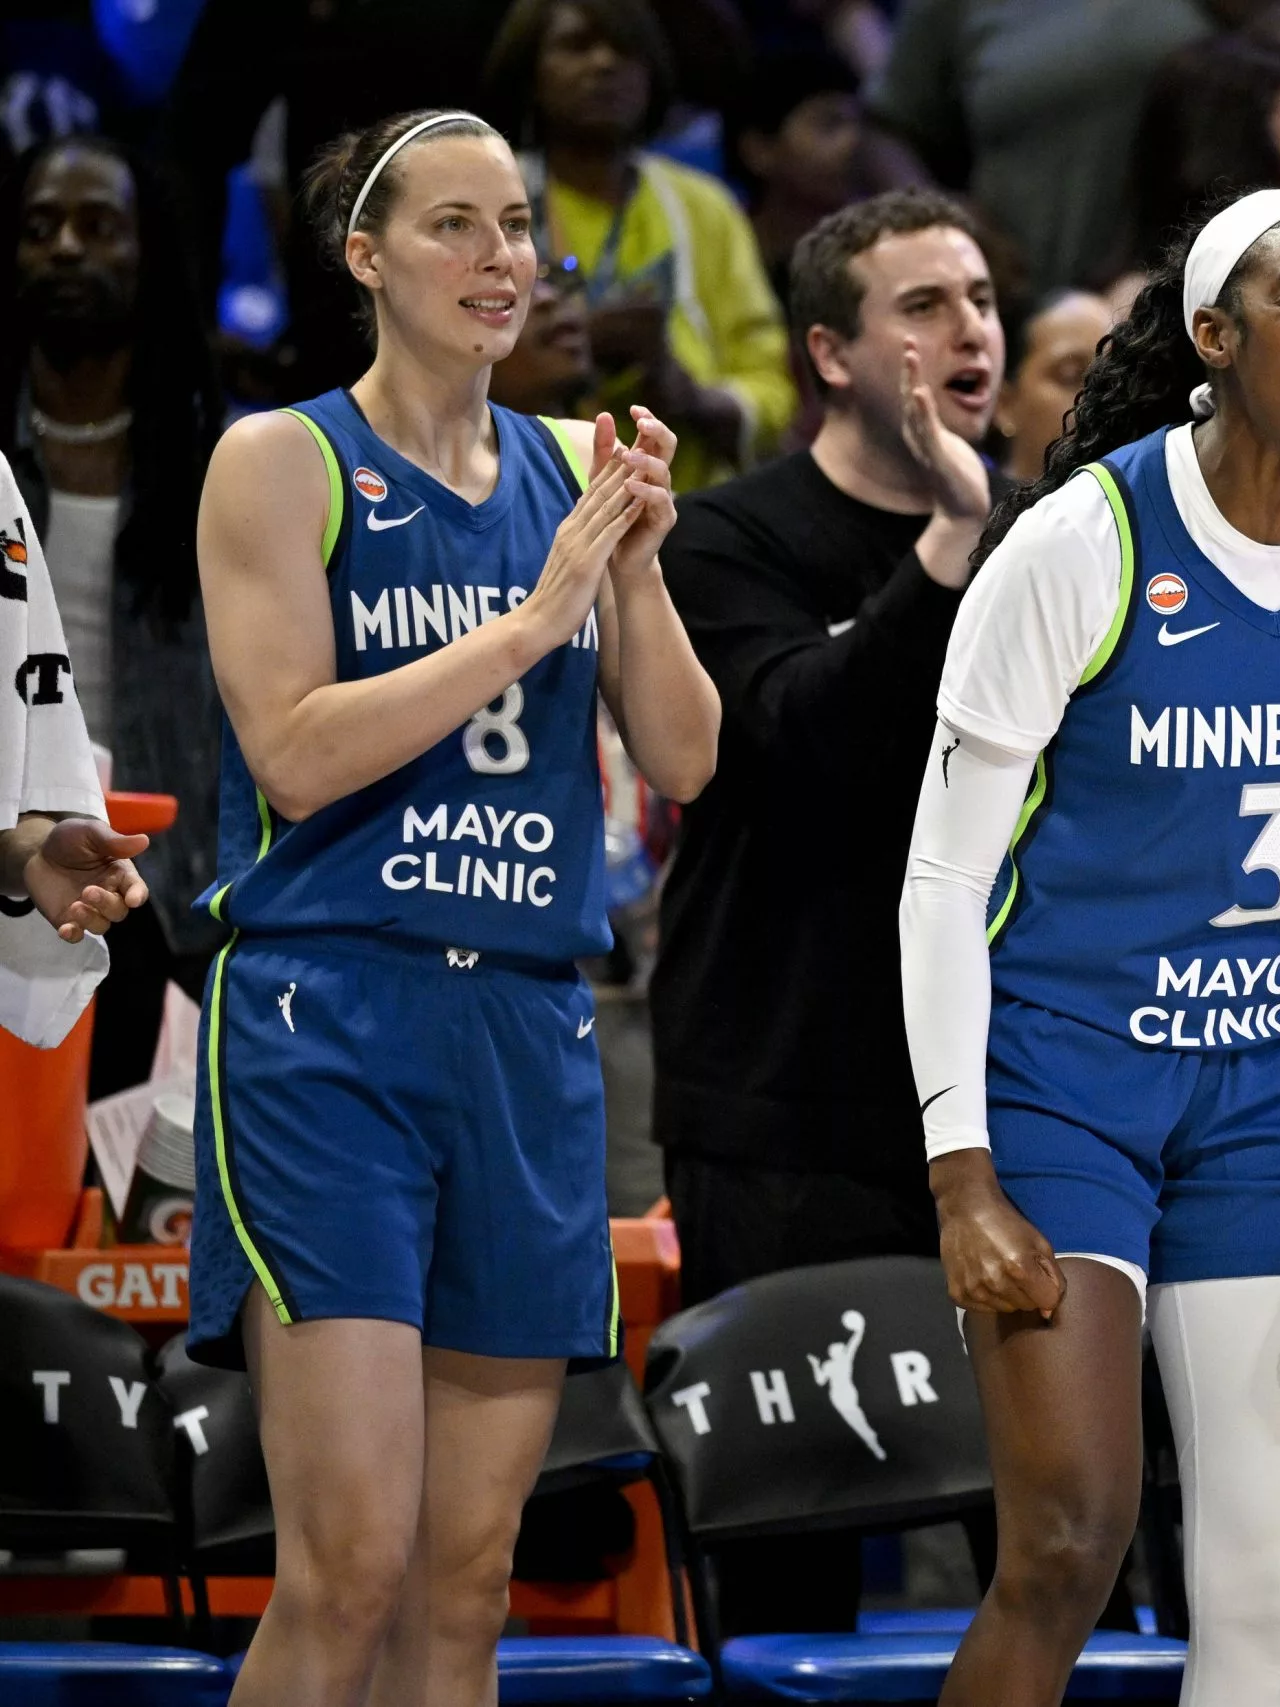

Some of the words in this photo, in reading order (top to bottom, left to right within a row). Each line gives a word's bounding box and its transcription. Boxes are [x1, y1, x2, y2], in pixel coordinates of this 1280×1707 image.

[351, 584, 599, 652] MINNESA
[462, 680, 531, 775] 8
[403, 804, 554, 853] MAYO
[381, 852, 557, 907] CLINIC
